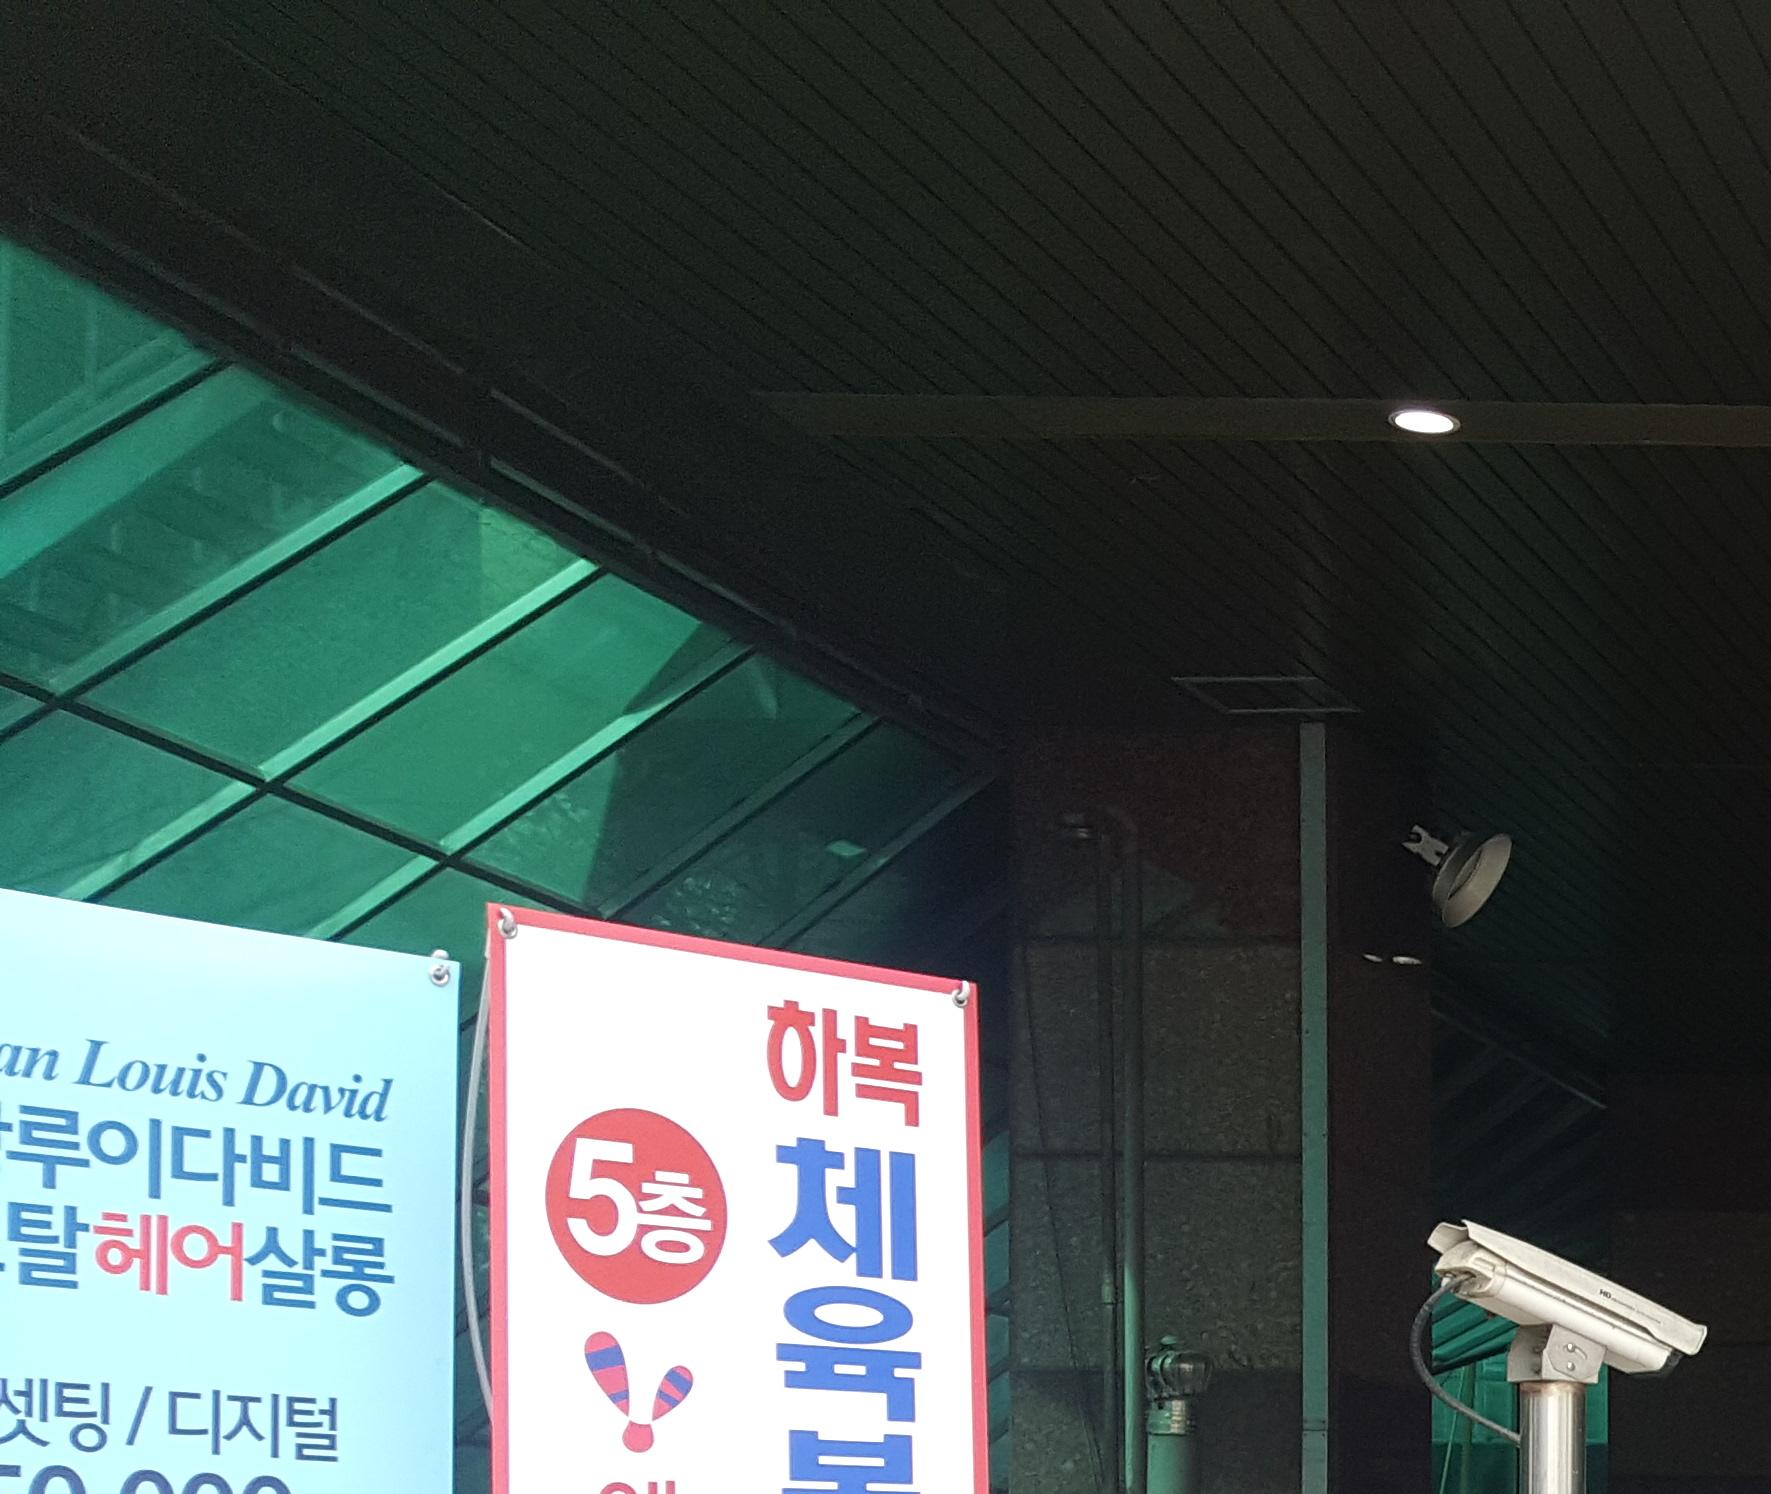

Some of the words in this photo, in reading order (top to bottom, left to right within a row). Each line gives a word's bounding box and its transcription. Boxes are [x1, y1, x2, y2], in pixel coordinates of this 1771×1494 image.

[74, 1038, 228, 1102] Louis
[238, 1060, 394, 1122] David
[767, 999, 924, 1128] 하복
[0, 1104, 393, 1215] 루이다비드
[567, 1137, 712, 1265] 5층
[0, 1201, 395, 1317] 탈헤어살롱
[168, 1389, 339, 1462] 디지털
